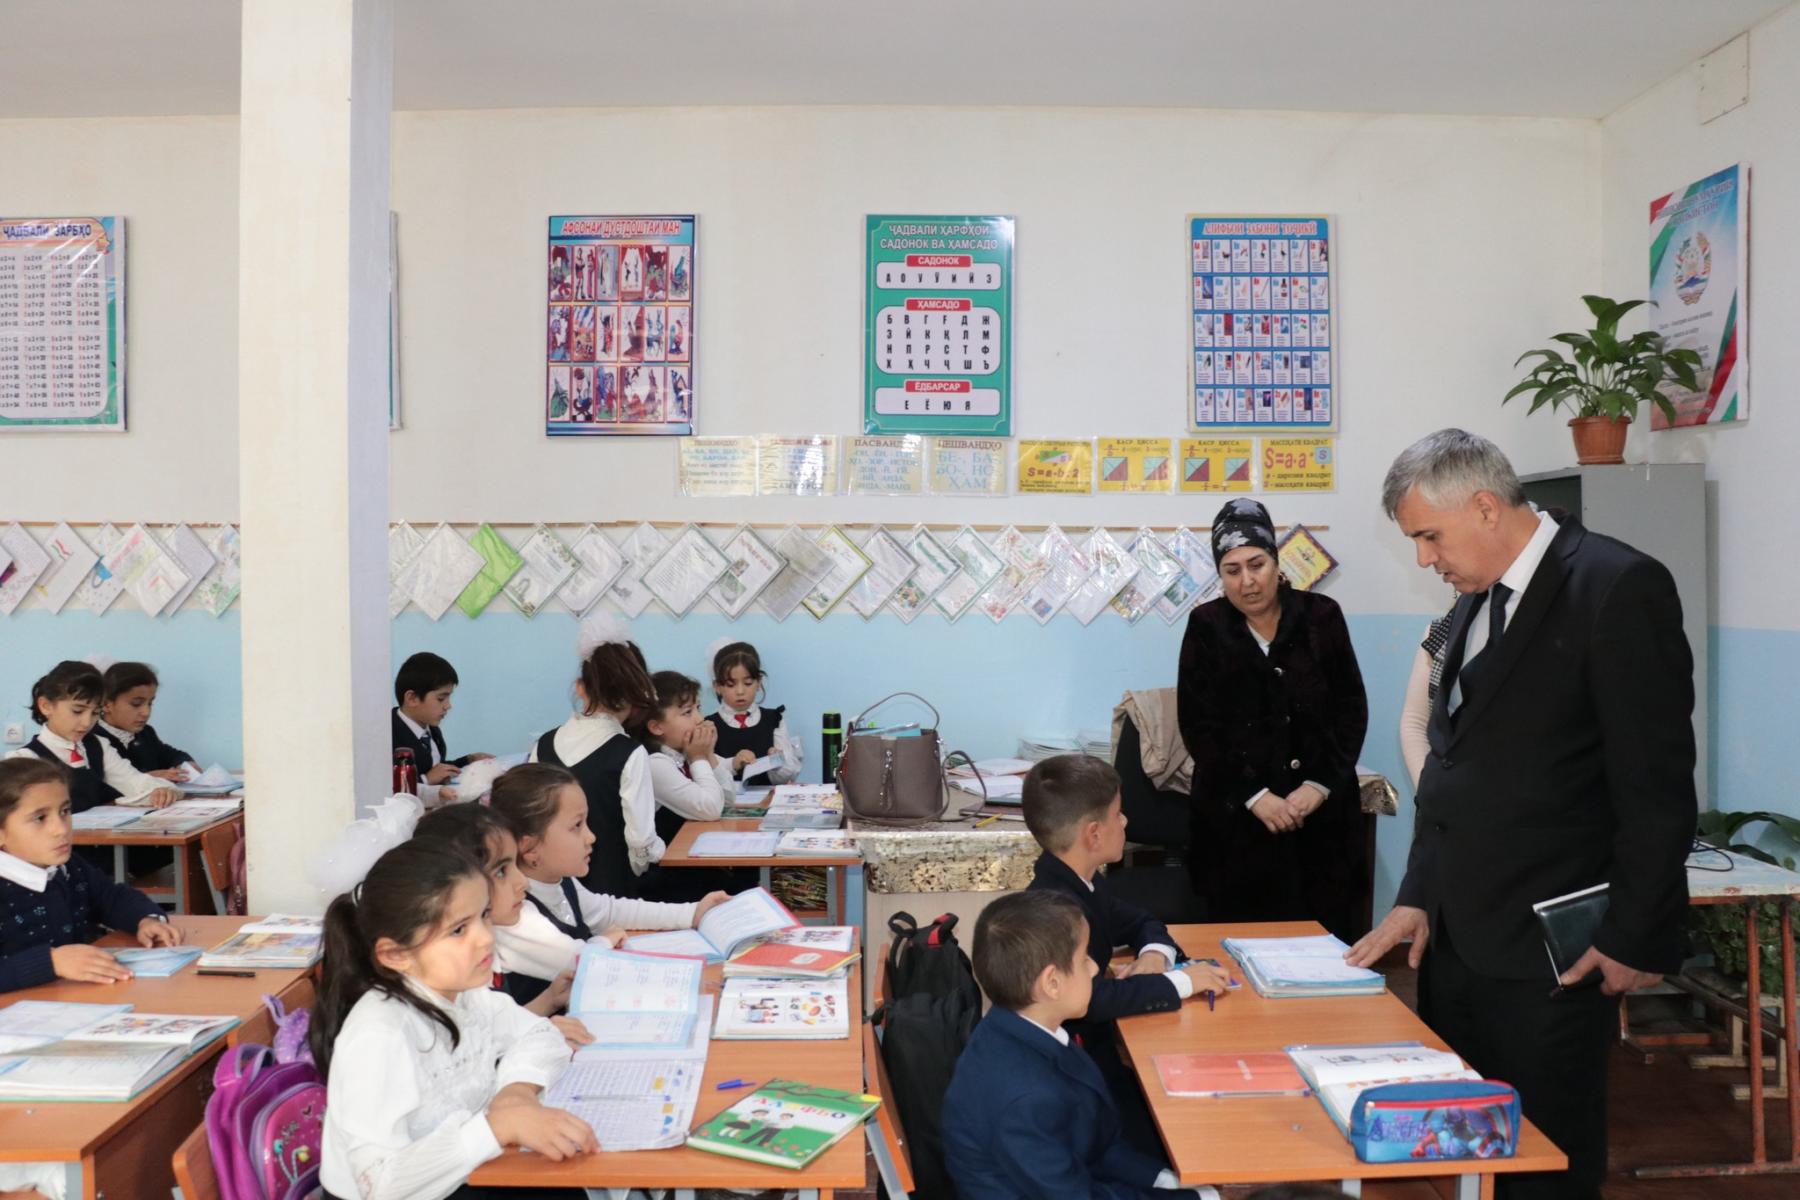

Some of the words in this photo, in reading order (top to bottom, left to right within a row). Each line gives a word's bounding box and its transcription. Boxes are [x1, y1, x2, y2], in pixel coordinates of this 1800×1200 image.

[661, 220, 681, 233] МАН
[880, 239, 929, 250] САДОНОК
[931, 239, 945, 249] ВА
[948, 239, 998, 250] ҲАМСАДО
[918, 256, 960, 266] САДОНОК
[917, 300, 960, 310] ҲАМСАДО
